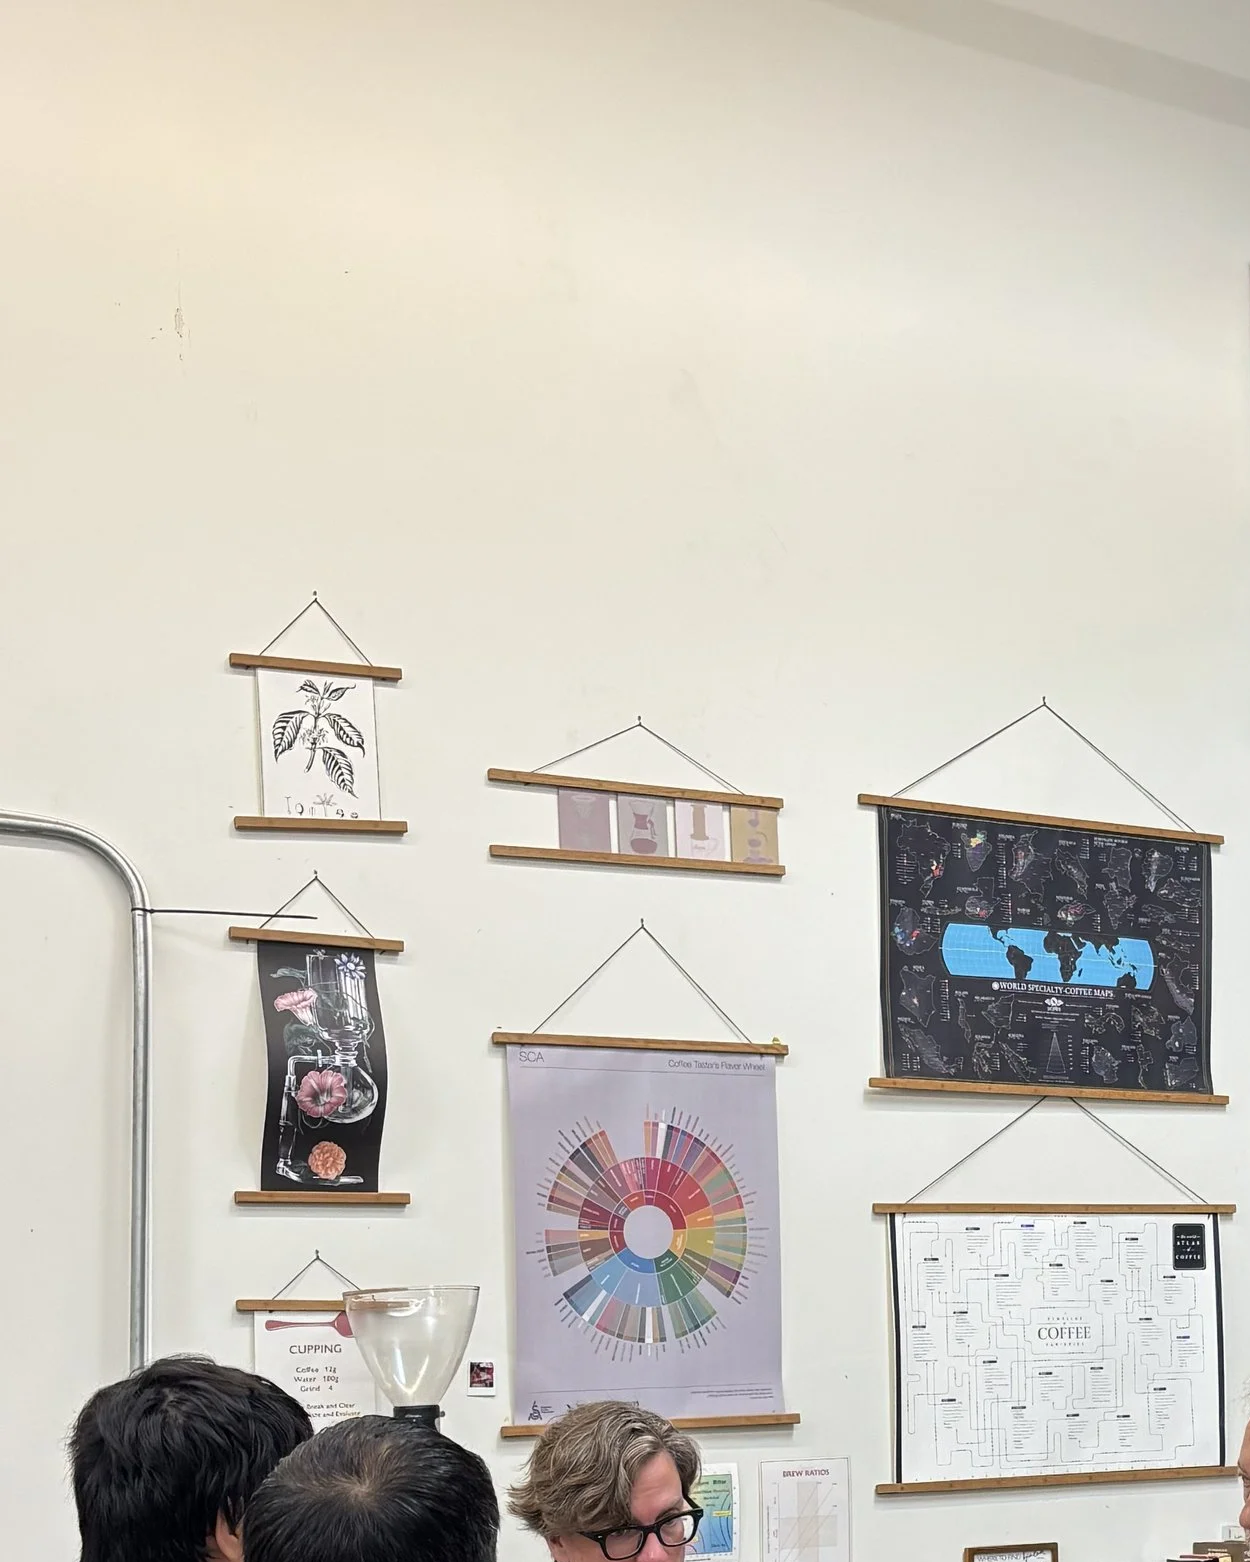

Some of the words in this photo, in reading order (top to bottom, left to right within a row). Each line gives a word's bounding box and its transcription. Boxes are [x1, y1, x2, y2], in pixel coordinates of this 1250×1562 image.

[1000, 981, 1027, 991] WORLD
[518, 1051, 545, 1063] SCA
[668, 1059, 692, 1068] Coffee
[1037, 1326, 1092, 1341] COFFEE
[289, 1343, 342, 1355] CUPPING
[295, 1366, 320, 1374] Coffee
[783, 1470, 804, 1478] BREW
[805, 1469, 830, 1477] RATIOS
